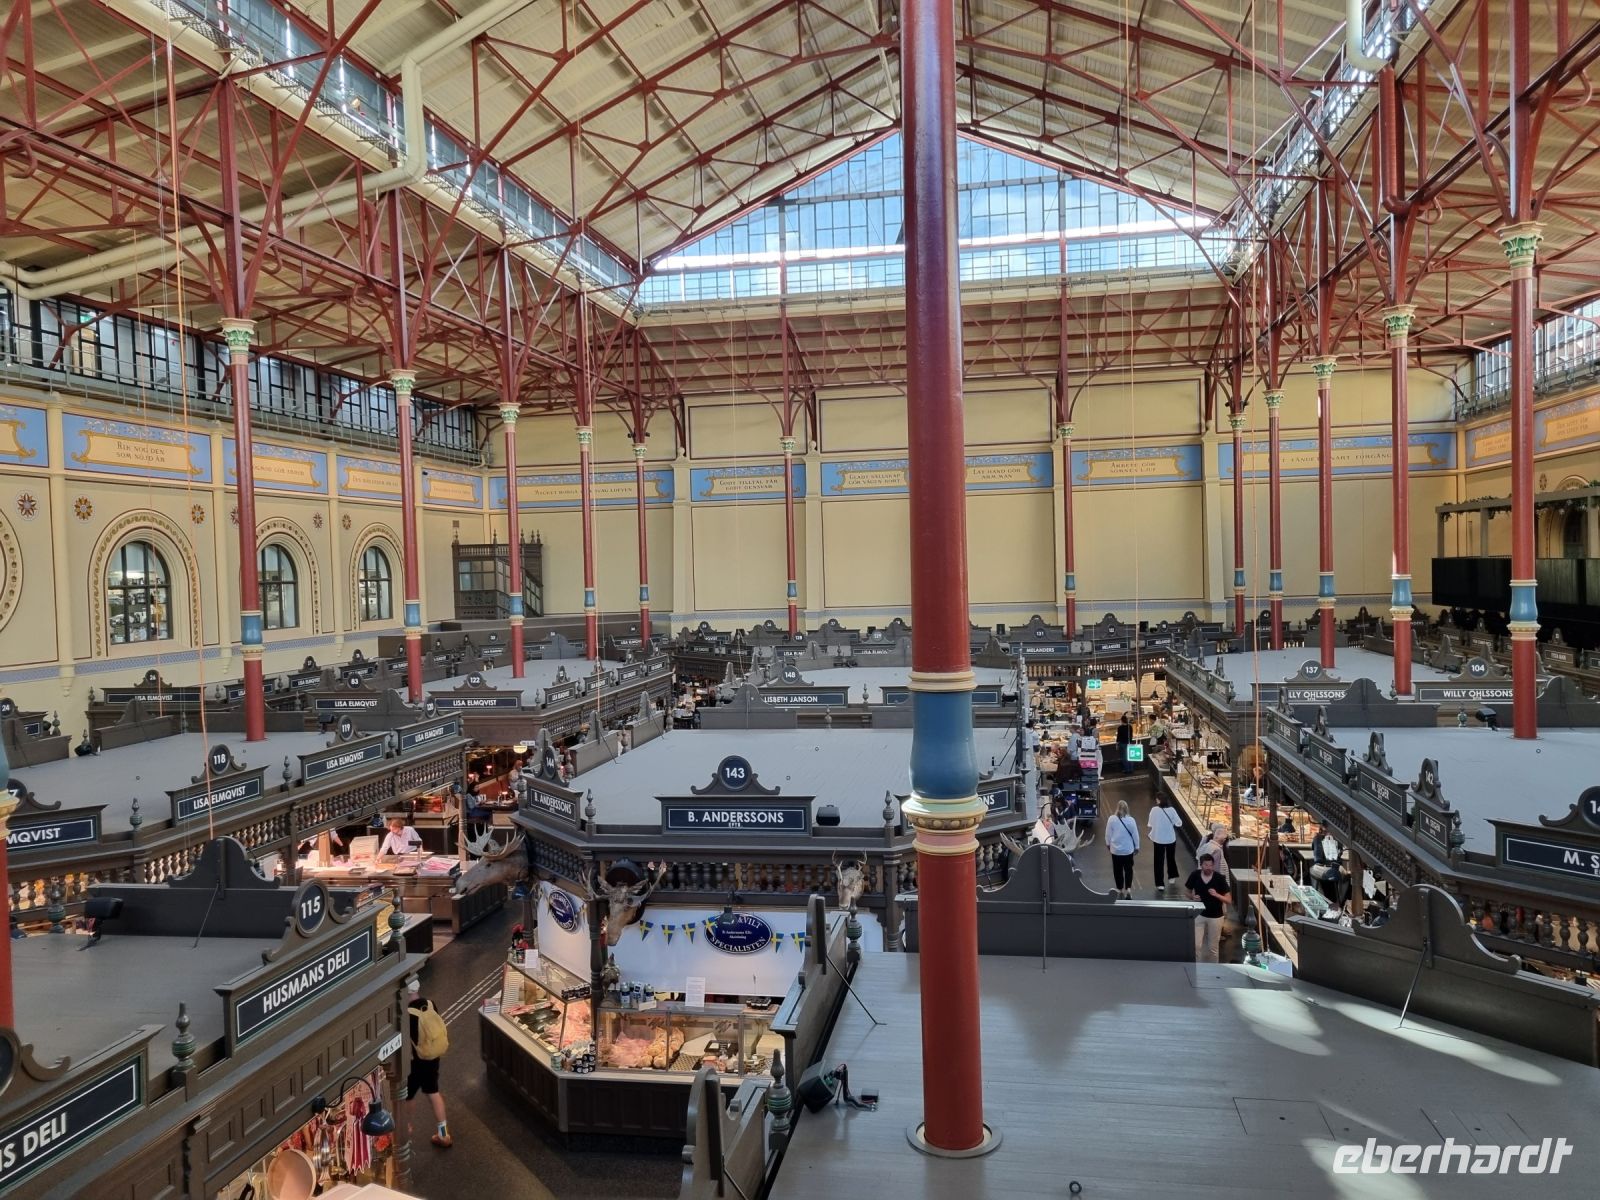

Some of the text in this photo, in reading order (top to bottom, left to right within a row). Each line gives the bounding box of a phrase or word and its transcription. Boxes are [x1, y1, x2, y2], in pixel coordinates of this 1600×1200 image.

[784, 671, 796, 679] 148
[1305, 666, 1319, 674] 137
[1471, 664, 1485, 673] 104
[470, 676, 481, 684] 122
[763, 696, 788, 704] LISBETH
[1288, 691, 1346, 699] LLY OHLSSONS
[1469, 690, 1513, 699] OHLSSONS
[334, 699, 378, 708] LISA ELMQVIST
[341, 723, 351, 734] 119
[213, 753, 227, 766] 118
[326, 751, 365, 770] LISA ELMQVIST
[725, 767, 746, 779] 143
[193, 785, 247, 810] LISA ELMQVIST
[540, 794, 573, 815] ANDERSSONS
[687, 811, 785, 824] B. ANDERSSONS
[5, 828, 61, 845] MQVIST
[1563, 850, 1585, 867] M.
[301, 895, 321, 920] 115
[711, 935, 767, 952] SPECIALISTEN
[263, 948, 351, 1015] HUSMANS DELI
[23, 1112, 68, 1158] DELI
